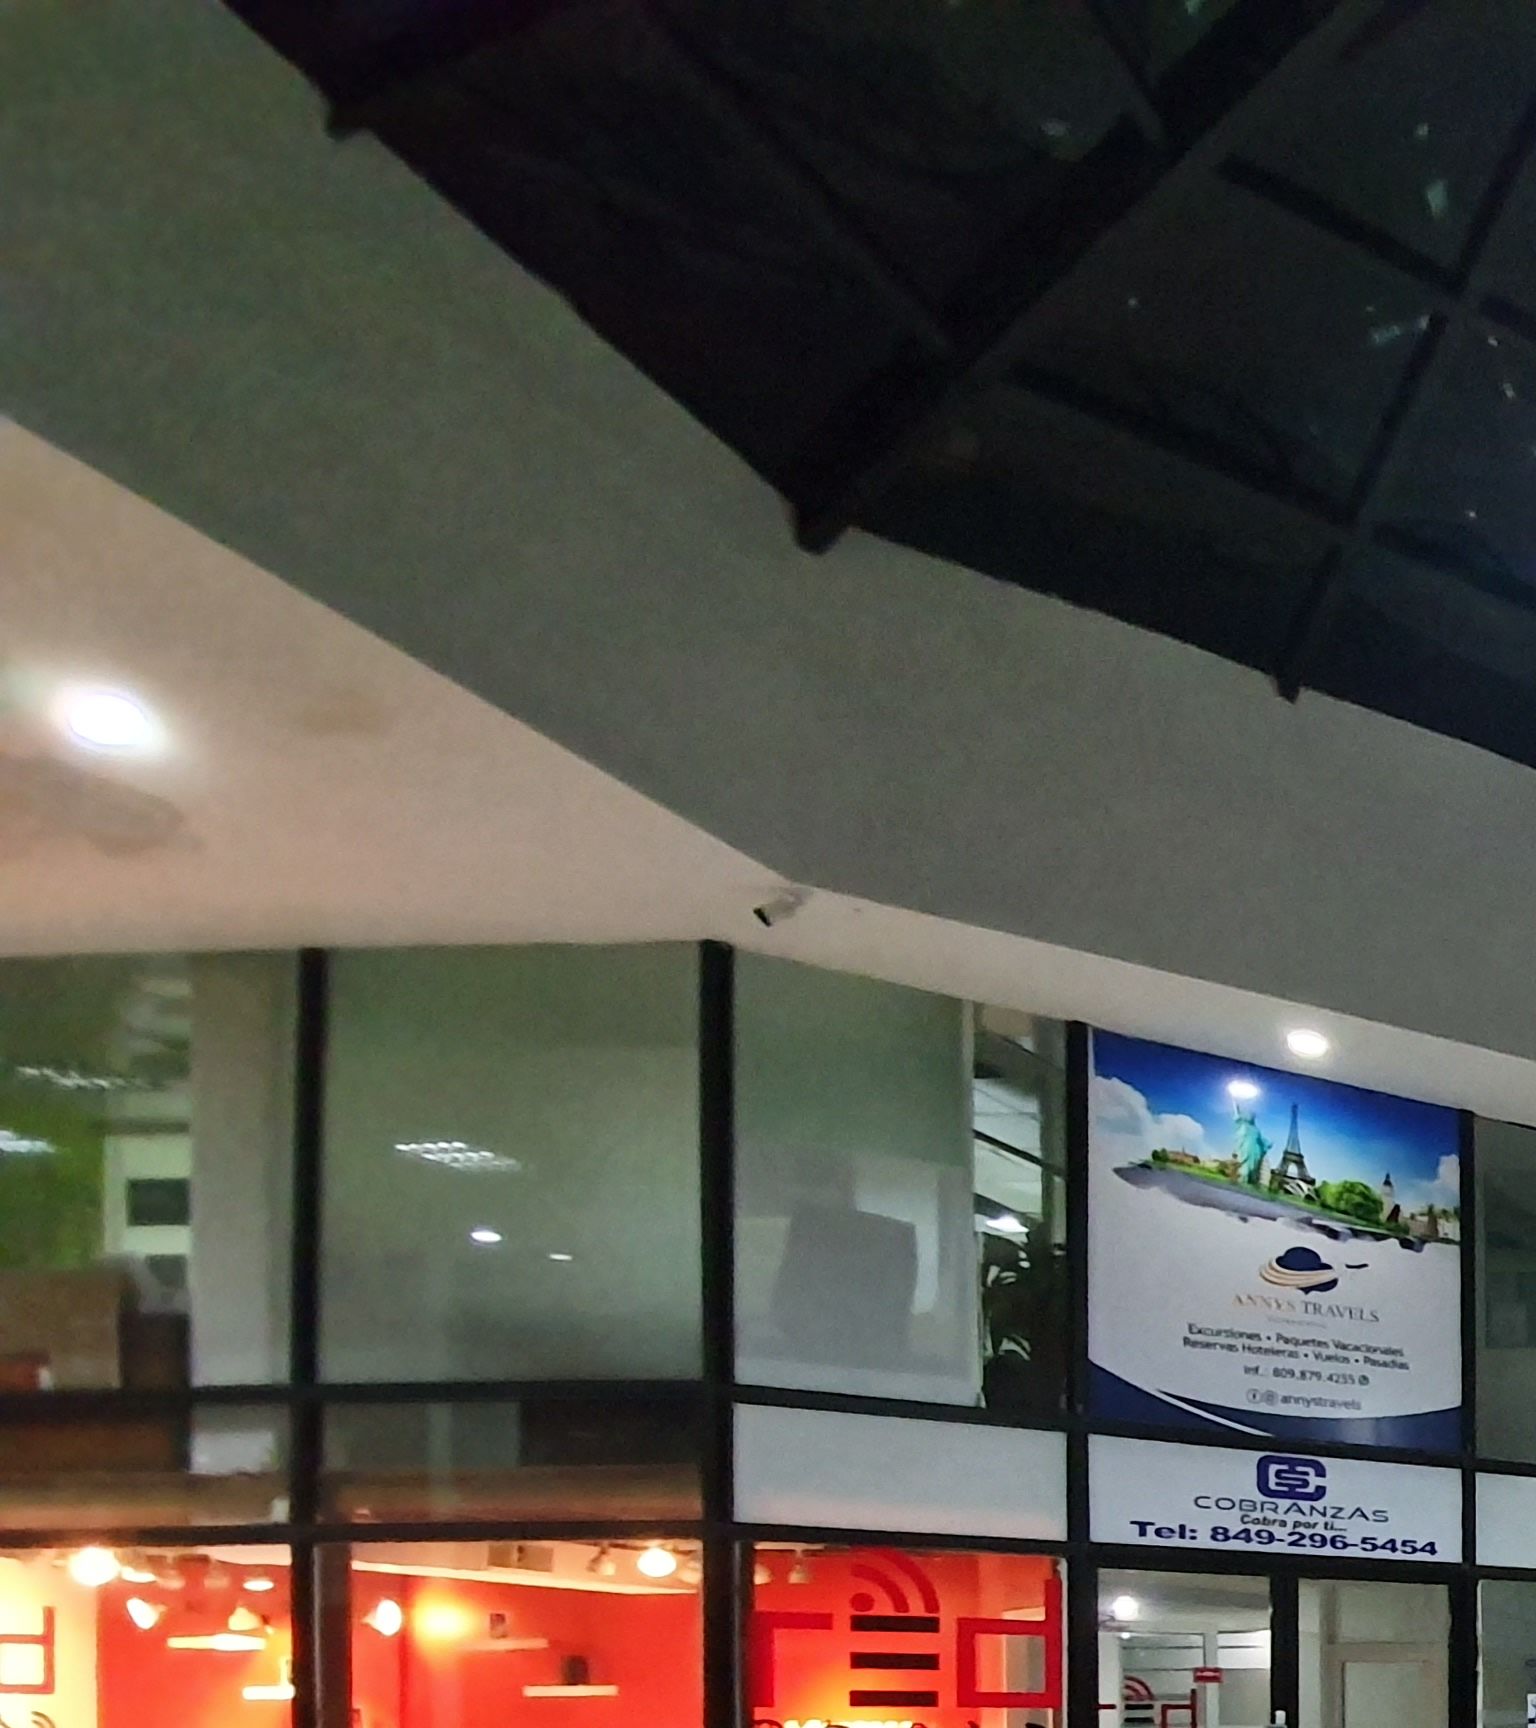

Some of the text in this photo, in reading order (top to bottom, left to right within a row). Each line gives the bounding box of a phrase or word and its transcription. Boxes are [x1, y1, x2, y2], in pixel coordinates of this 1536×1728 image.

[1301, 1299, 1380, 1322] TRAVELS
[1194, 1496, 1390, 1523] COBRANZAS
[1240, 1514, 1287, 1528] Cobra
[1292, 1520, 1318, 1531] por
[1130, 1521, 1438, 1556] Tel: 849-296-5454
